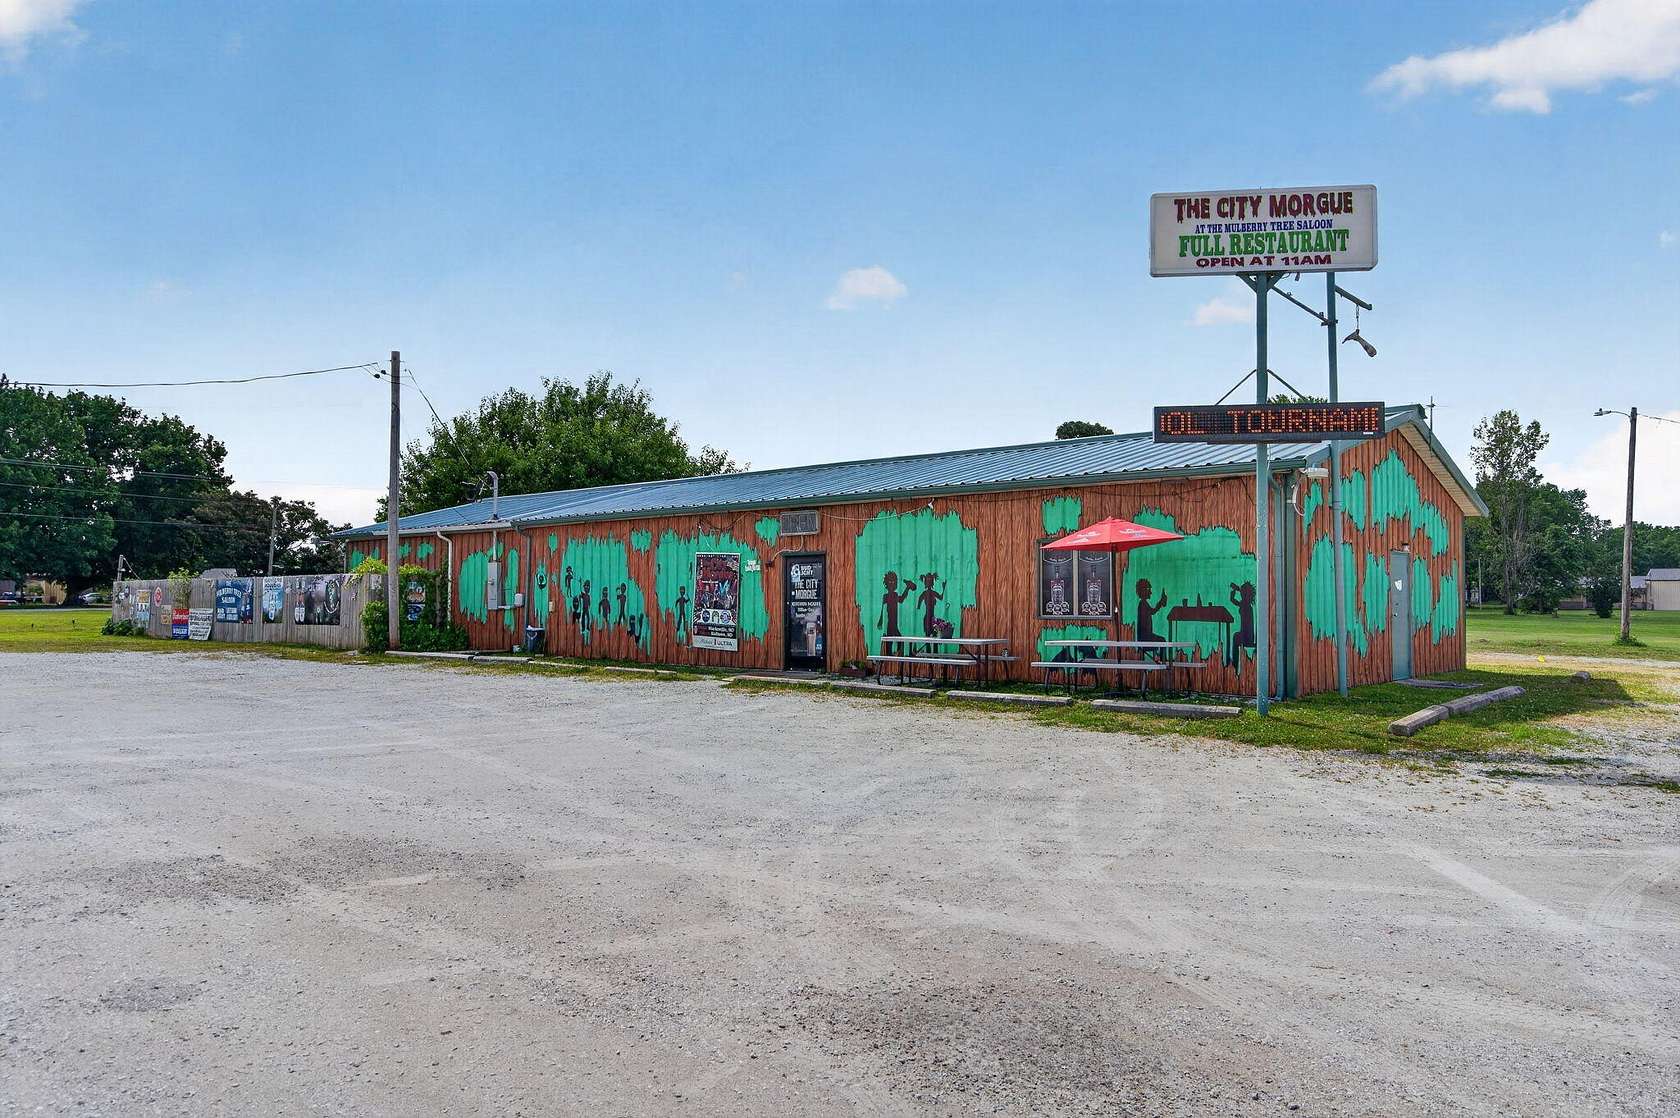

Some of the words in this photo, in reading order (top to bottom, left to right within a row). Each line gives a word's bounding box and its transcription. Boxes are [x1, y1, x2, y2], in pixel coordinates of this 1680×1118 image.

[1174, 198, 1211, 223] THE
[1217, 195, 1263, 221] CITY
[1269, 191, 1354, 219] MORGUE
[1195, 224, 1205, 234] AT
[1206, 223, 1223, 234] THE
[1224, 222, 1268, 233] MULBERRY
[1270, 220, 1295, 231] TREE
[1297, 219, 1333, 230] SALOON
[1179, 234, 1225, 257] FULL
[1229, 229, 1350, 256] RESTAURANT
[1196, 257, 1245, 268] OPEN
[1250, 256, 1276, 266] AT
[1281, 254, 1332, 266] 11AM
[806, 578, 818, 589] CITY
[795, 589, 818, 600] MORGUE
